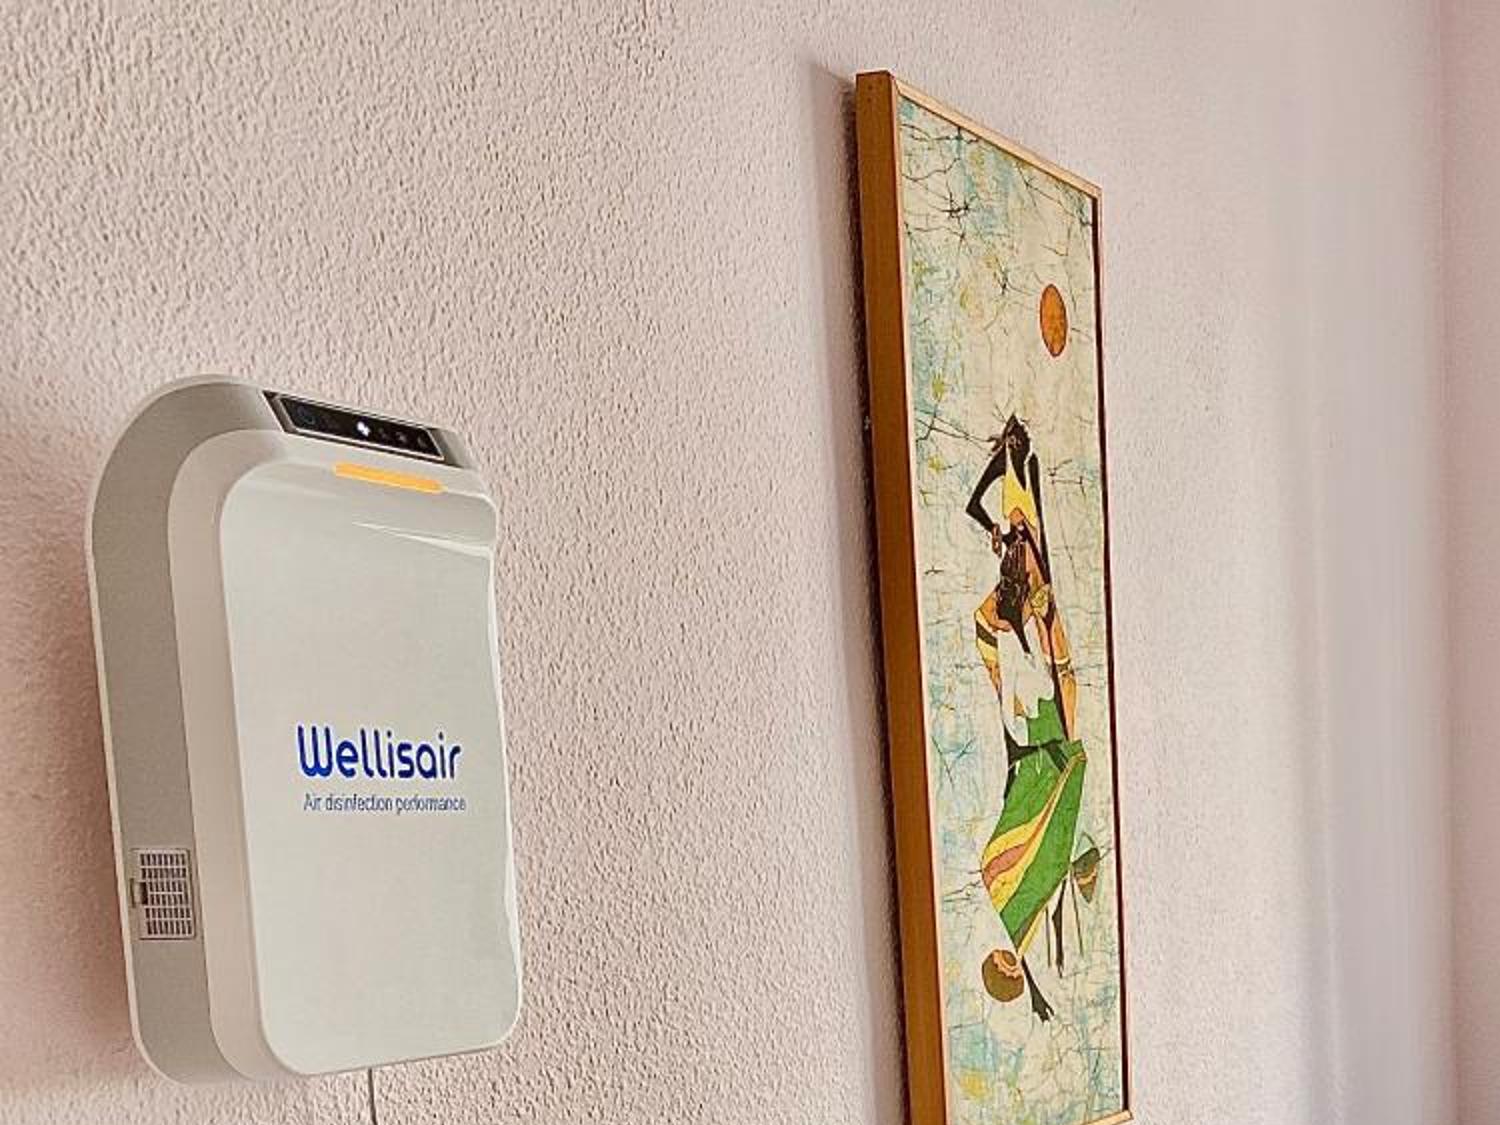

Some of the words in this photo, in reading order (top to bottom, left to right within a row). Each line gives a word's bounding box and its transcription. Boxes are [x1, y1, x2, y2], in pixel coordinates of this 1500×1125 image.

[297, 725, 462, 779] Wellisair
[303, 793, 323, 811] Air
[325, 793, 393, 812] disinfection
[395, 795, 466, 816] performance
